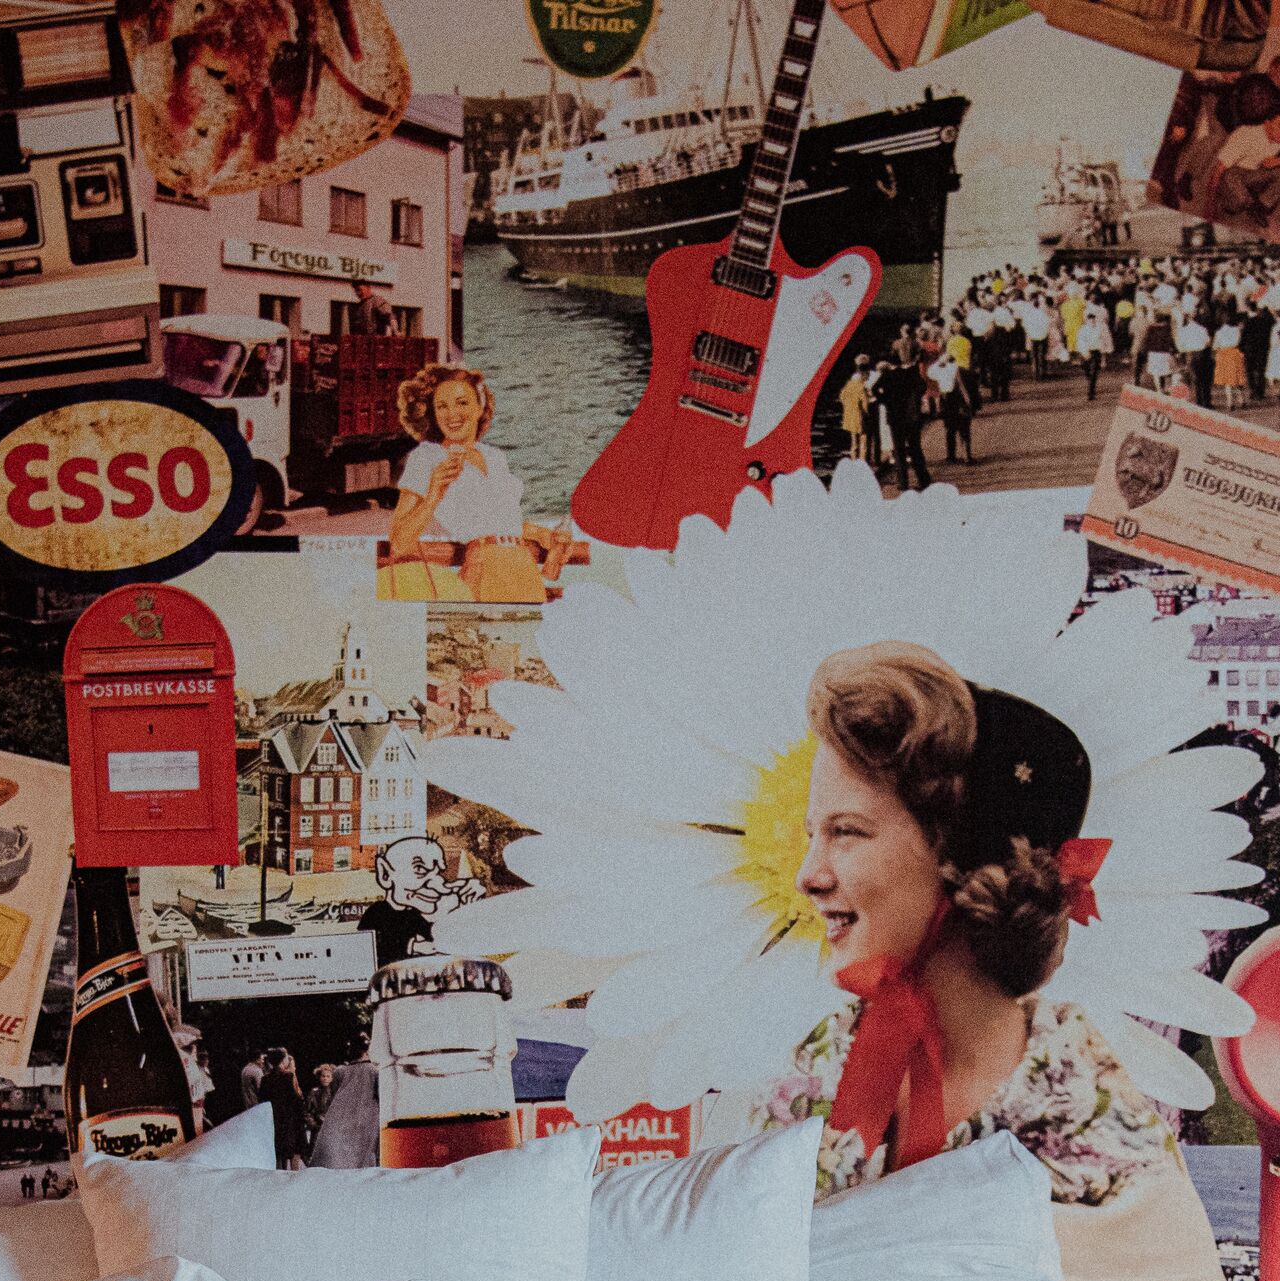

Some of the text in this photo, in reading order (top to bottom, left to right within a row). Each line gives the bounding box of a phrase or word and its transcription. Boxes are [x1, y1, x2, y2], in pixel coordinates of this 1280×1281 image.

[3, 442, 211, 528] ESSO
[82, 678, 217, 698] POSTBREVKASSE
[544, 1118, 680, 1142] VXHALL
